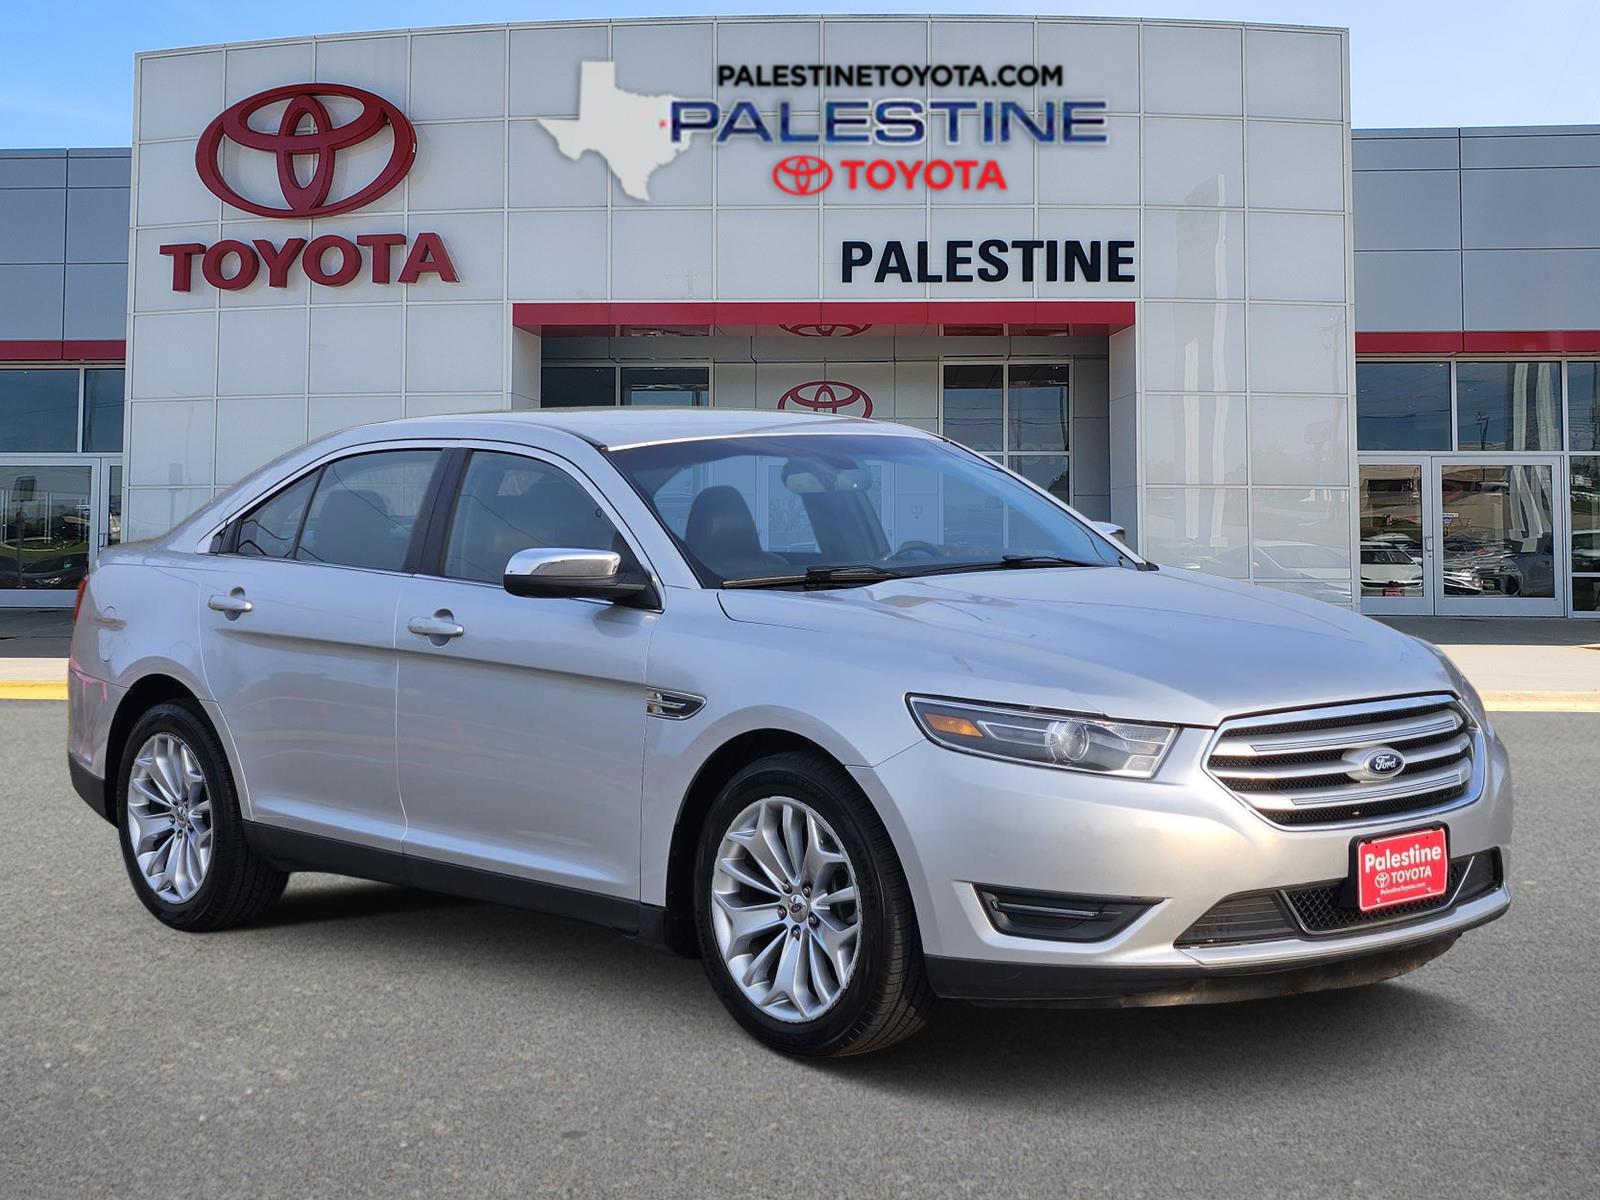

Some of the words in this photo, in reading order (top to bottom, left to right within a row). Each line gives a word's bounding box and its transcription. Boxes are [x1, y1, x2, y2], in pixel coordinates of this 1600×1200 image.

[159, 232, 461, 292] TOYOTA
[841, 240, 1136, 284] PALESTINE
[1375, 756, 1396, 770] Ford
[1364, 844, 1442, 873] Palestine
[1391, 866, 1432, 883] TOYOTA
